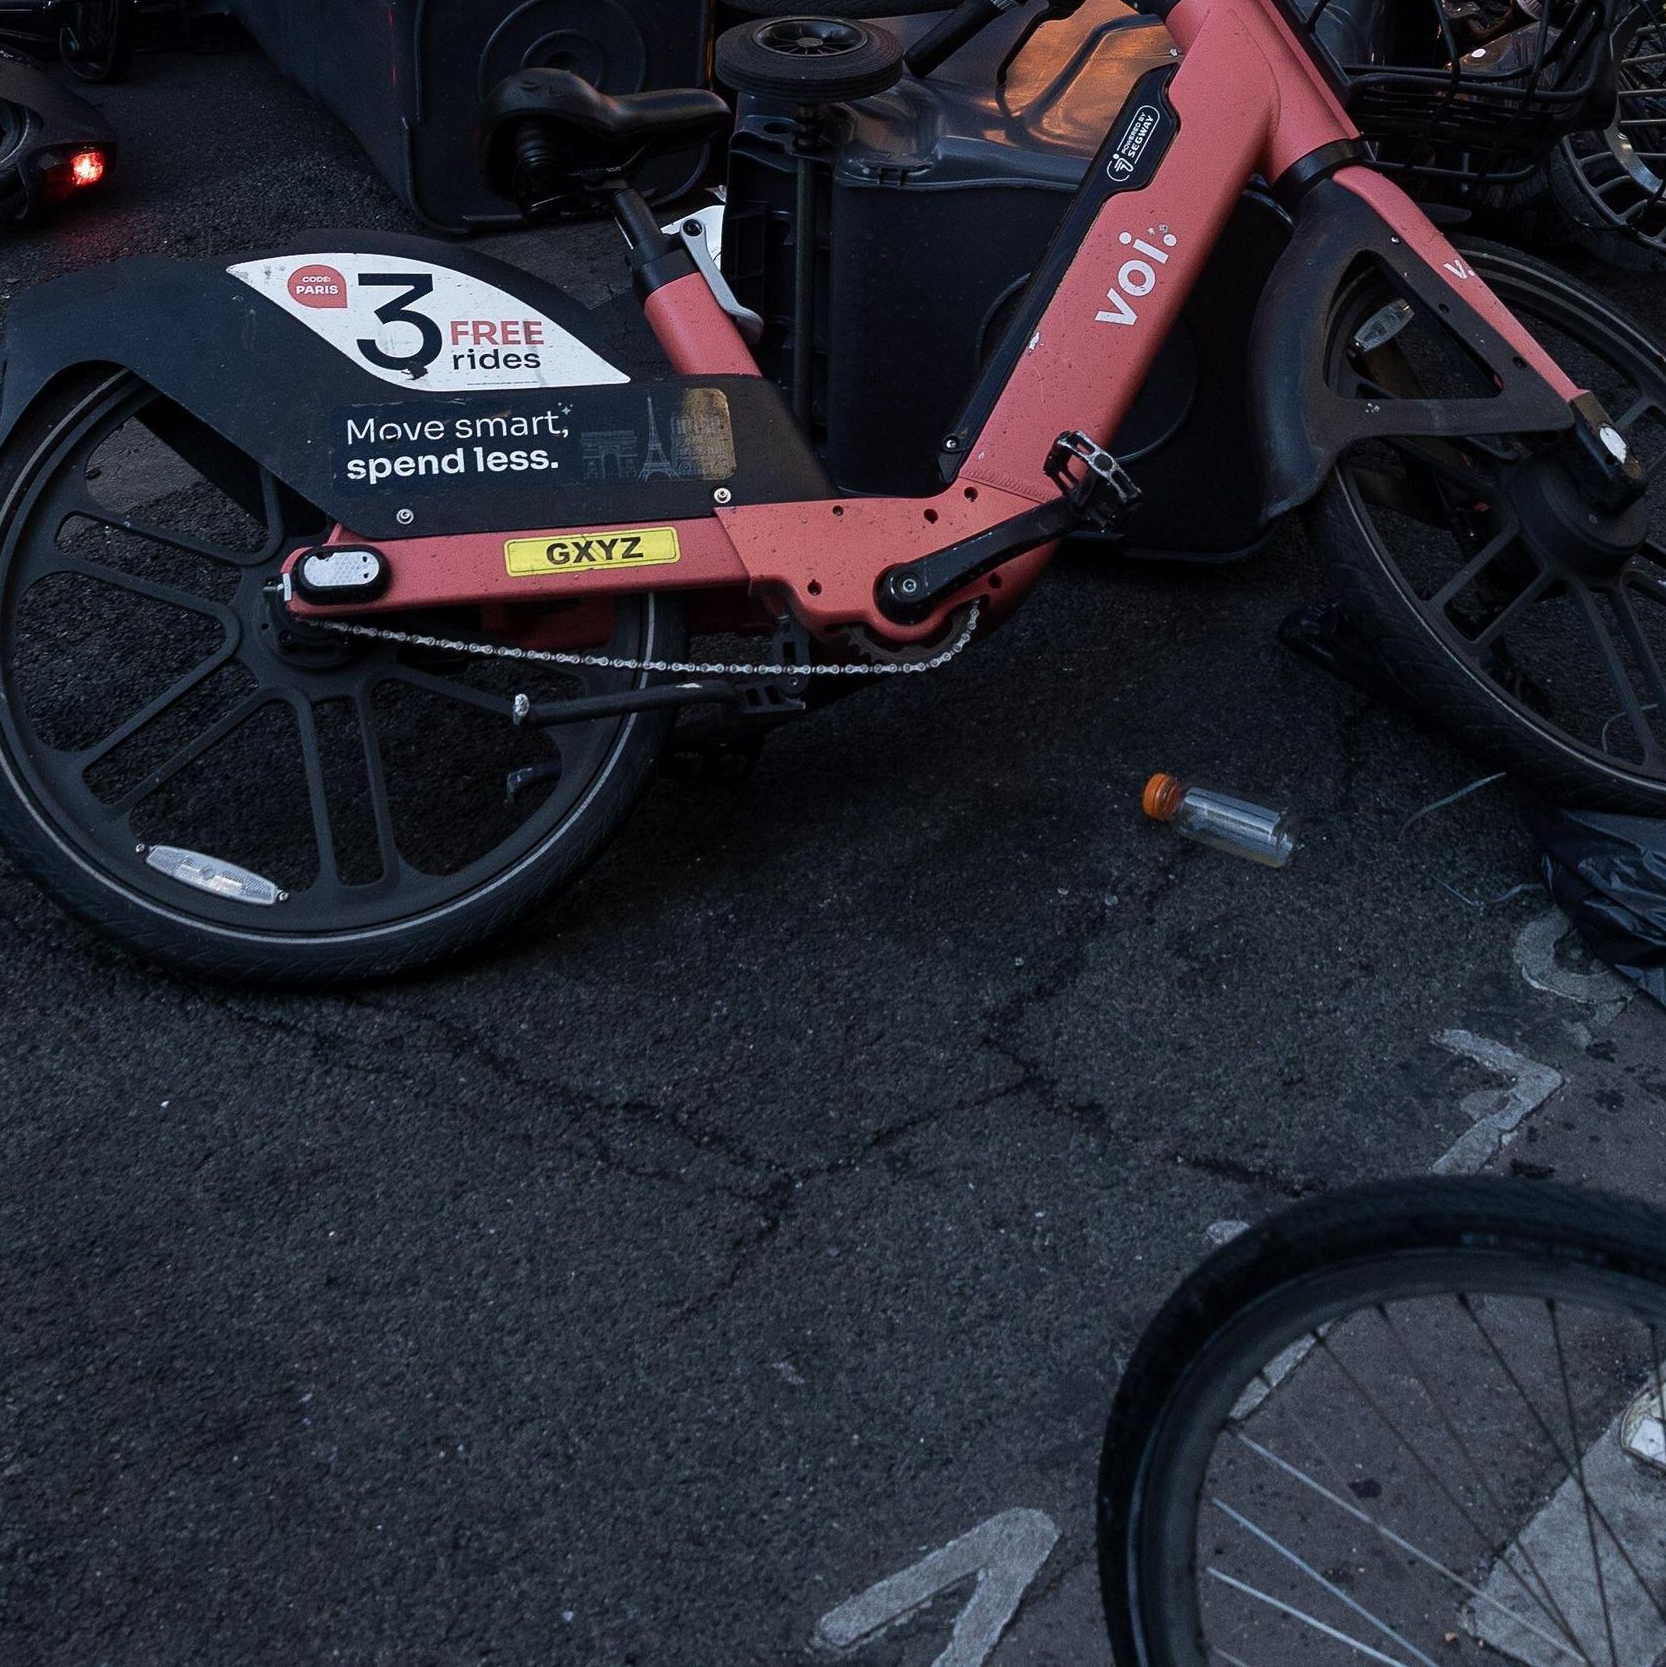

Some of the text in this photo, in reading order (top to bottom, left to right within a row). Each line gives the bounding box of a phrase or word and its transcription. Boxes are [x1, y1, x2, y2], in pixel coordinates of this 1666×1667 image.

[1120, 111, 1148, 155] POWERED BY
[1127, 114, 1155, 158] SEGWAY
[295, 284, 340, 295] PARIS
[301, 275, 332, 283] CODE:
[356, 272, 443, 371] 3
[450, 319, 545, 346] FREE
[452, 347, 541, 371] rides
[346, 410, 570, 446] Move smart,
[346, 445, 560, 485] spend less.
[545, 536, 645, 565] GXYZ
